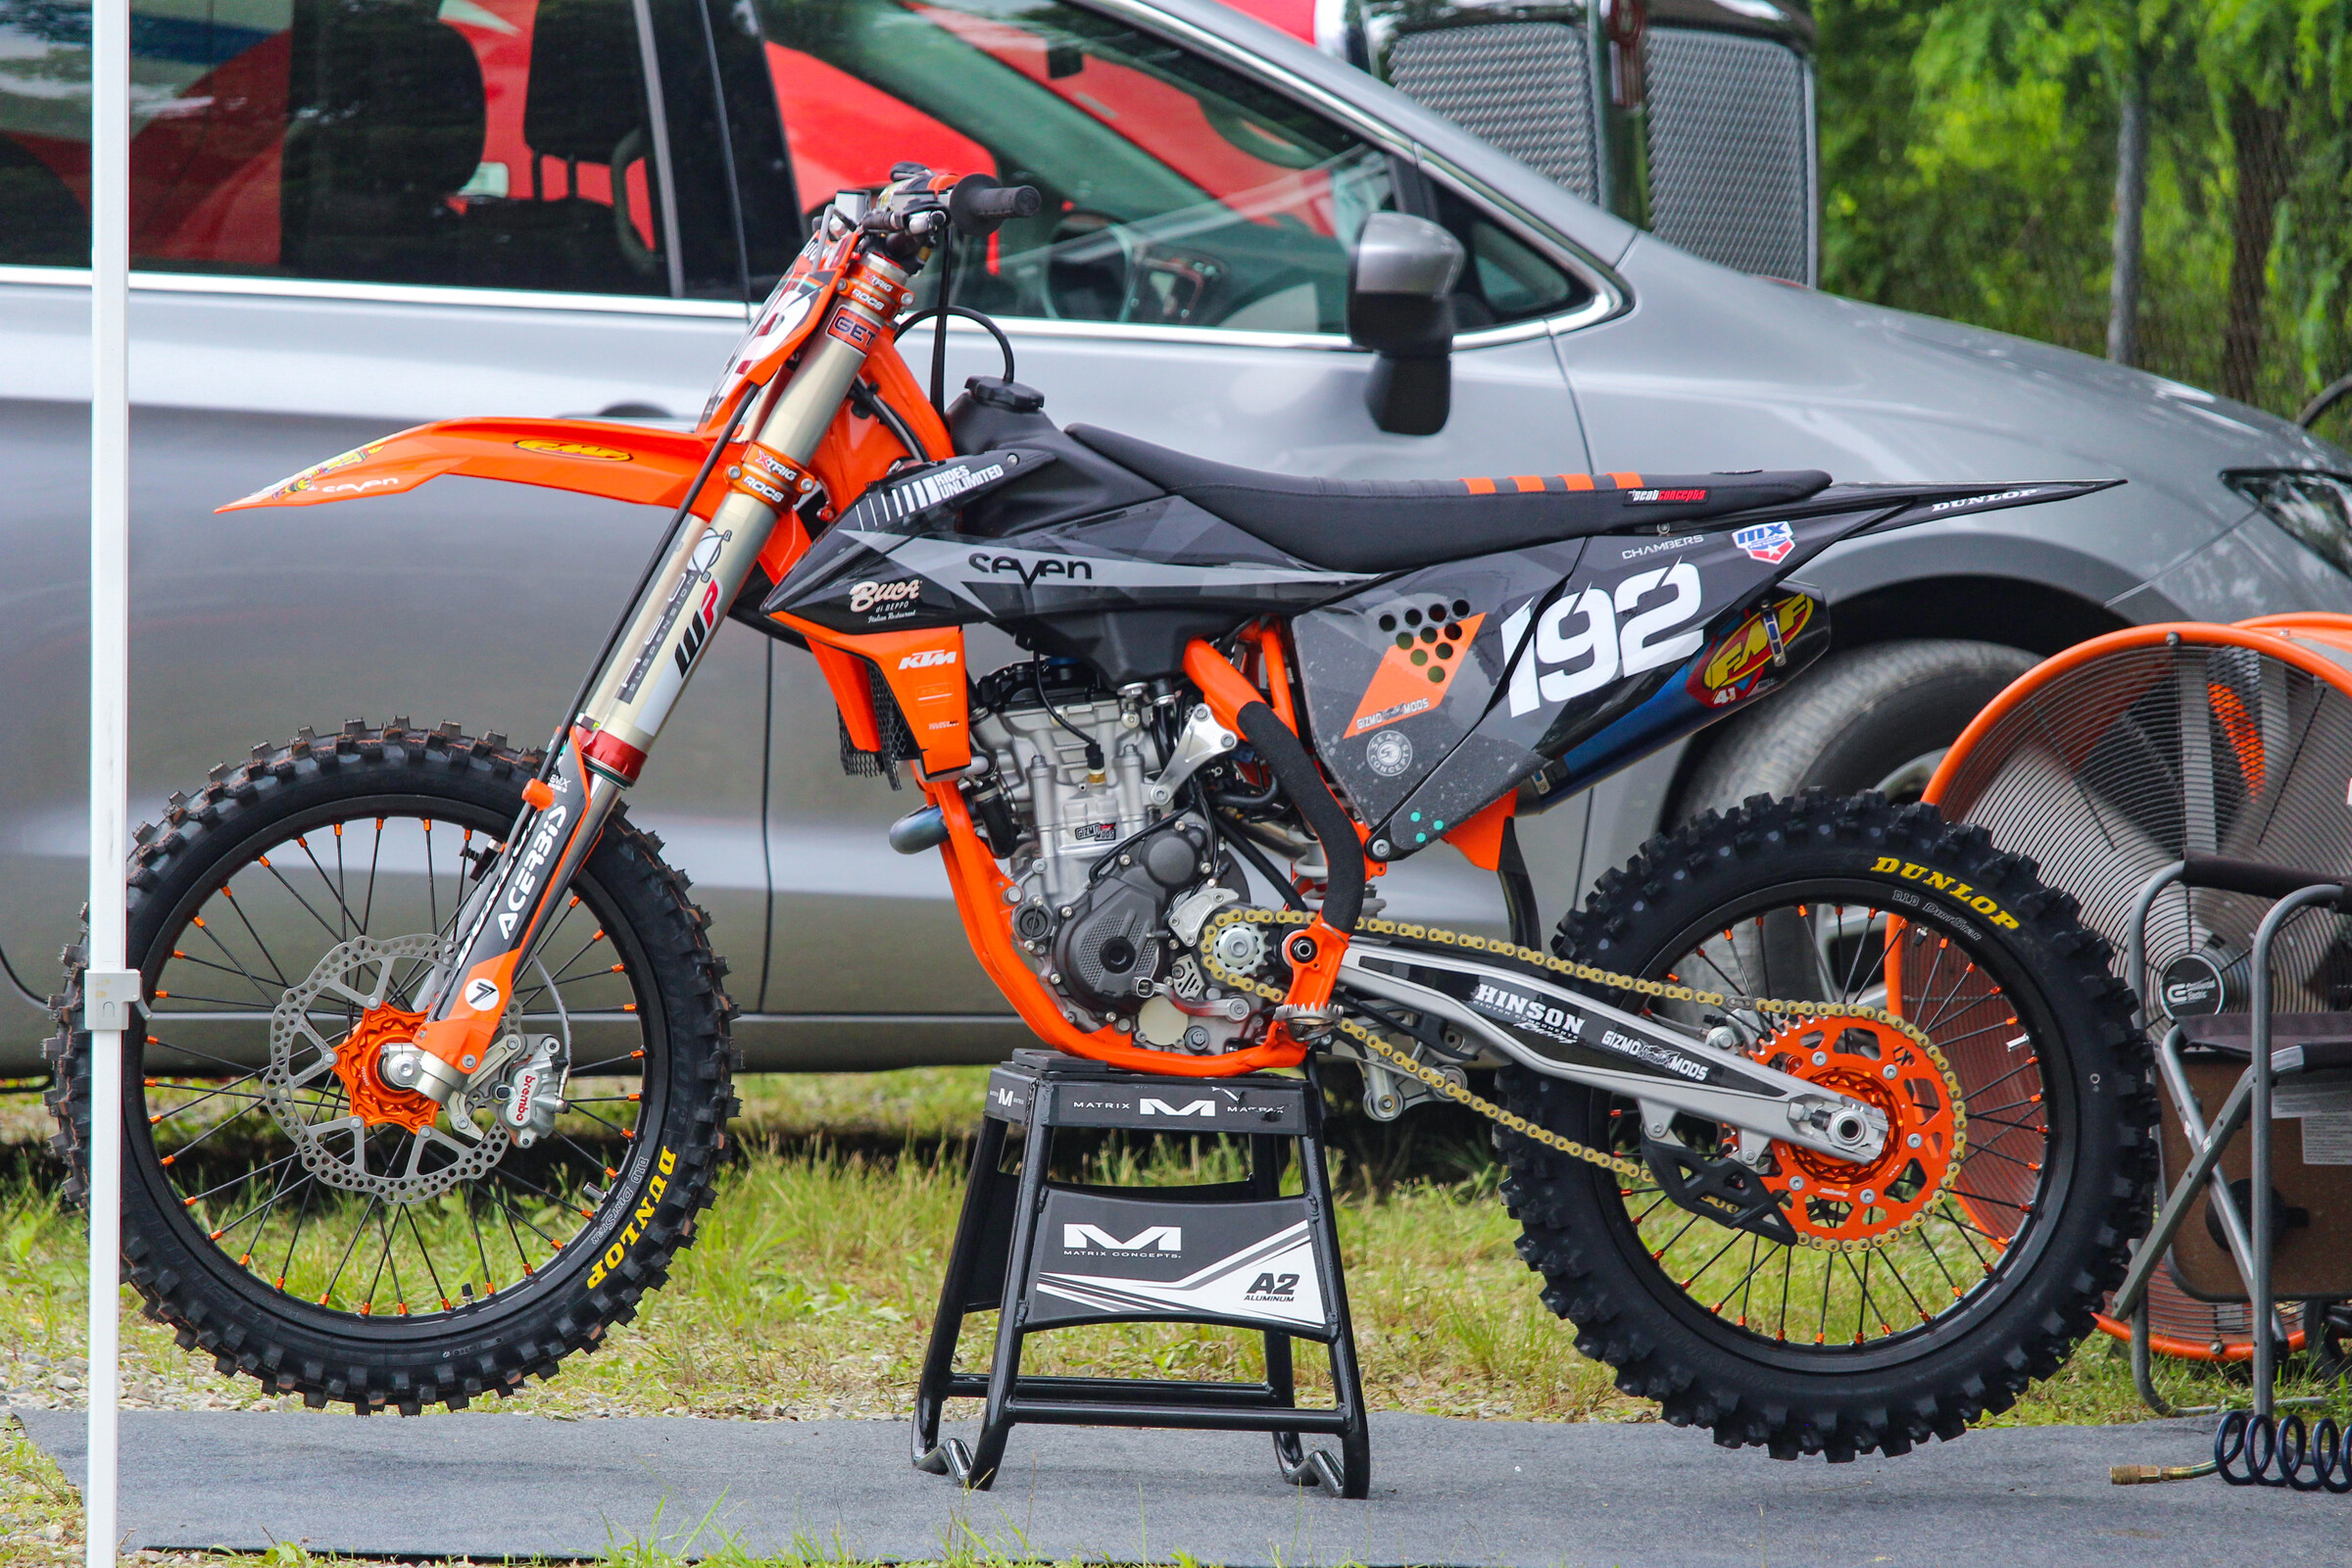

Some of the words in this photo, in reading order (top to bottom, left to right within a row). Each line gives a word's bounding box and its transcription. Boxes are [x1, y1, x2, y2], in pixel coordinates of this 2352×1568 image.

[862, 269, 894, 292] XTRIG
[851, 288, 886, 312] ROCS
[834, 316, 877, 347] GET
[754, 449, 799, 482] XTRIG
[932, 464, 971, 488] RIDES
[743, 474, 785, 504] ROCS
[937, 464, 1005, 501] UNLIMITED
[1932, 488, 2038, 513] DUNLOP
[1621, 534, 1704, 561] CHAMBERS
[885, 601, 909, 612] BEPPO
[628, 574, 695, 692] SUSPENSION
[674, 578, 723, 679] WP
[1499, 554, 1705, 718] 192
[1710, 592, 1808, 691] FMF
[898, 649, 957, 670] KTM
[1355, 712, 1383, 730] GIZMO
[1401, 697, 1430, 715] MODS
[1371, 733, 1401, 752] SEAT
[1077, 824, 1100, 838] GIZMO
[1870, 856, 2021, 930] DUNLOP
[1473, 982, 1587, 1035] HINSON
[1600, 1029, 1642, 1057] GIZMO
[1667, 1056, 1710, 1082] MODS
[515, 1074, 533, 1122] brembo
[1073, 1101, 1130, 1110] MATRIX
[586, 1145, 678, 1290] DUNLOP
[1243, 1294, 1296, 1302] ALUMINUM
[1246, 1272, 1300, 1296] A2
